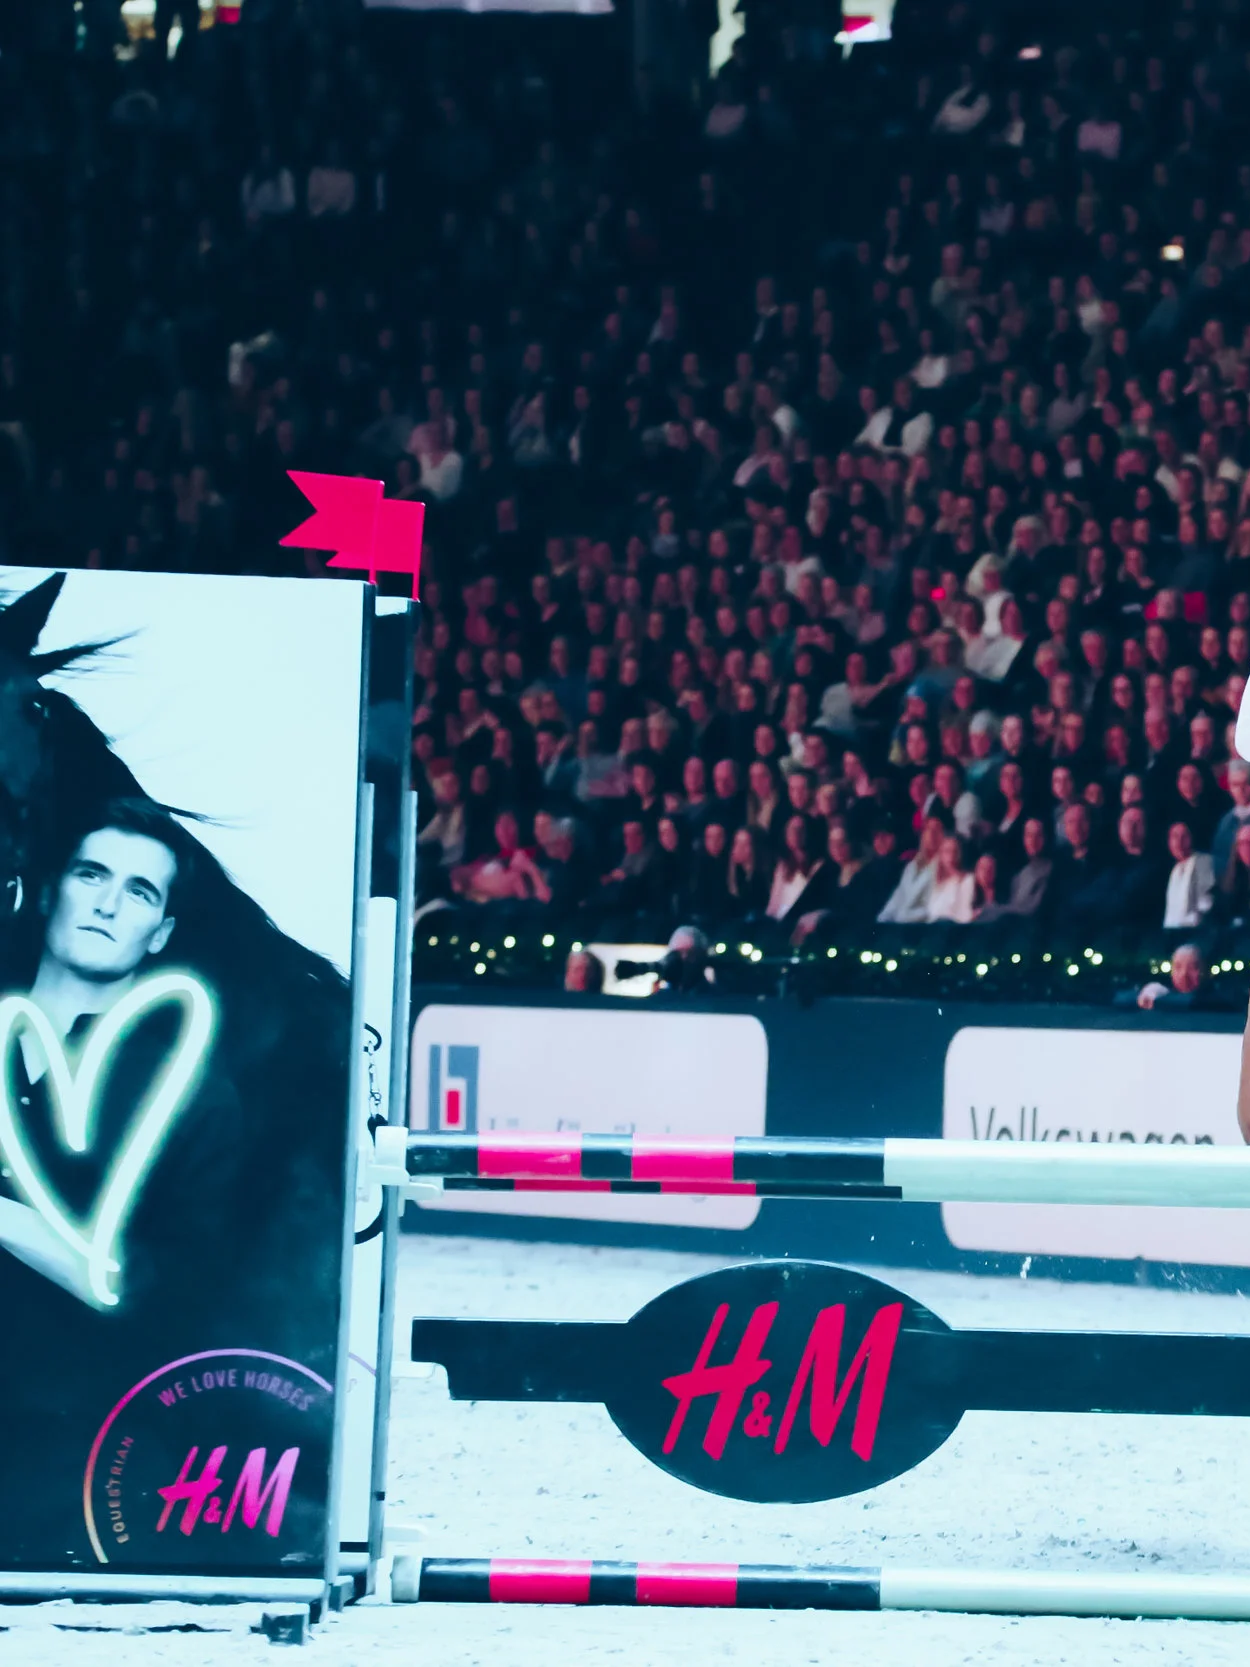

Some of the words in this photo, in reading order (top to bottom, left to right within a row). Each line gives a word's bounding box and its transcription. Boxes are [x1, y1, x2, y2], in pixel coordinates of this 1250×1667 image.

[158, 1381, 188, 1407] WE
[191, 1369, 238, 1392] LOVE
[244, 1371, 315, 1411] HORSES
[661, 1301, 904, 1461] H&M
[108, 1436, 134, 1544] EQUESTRIAN
[156, 1445, 300, 1537] H&M
